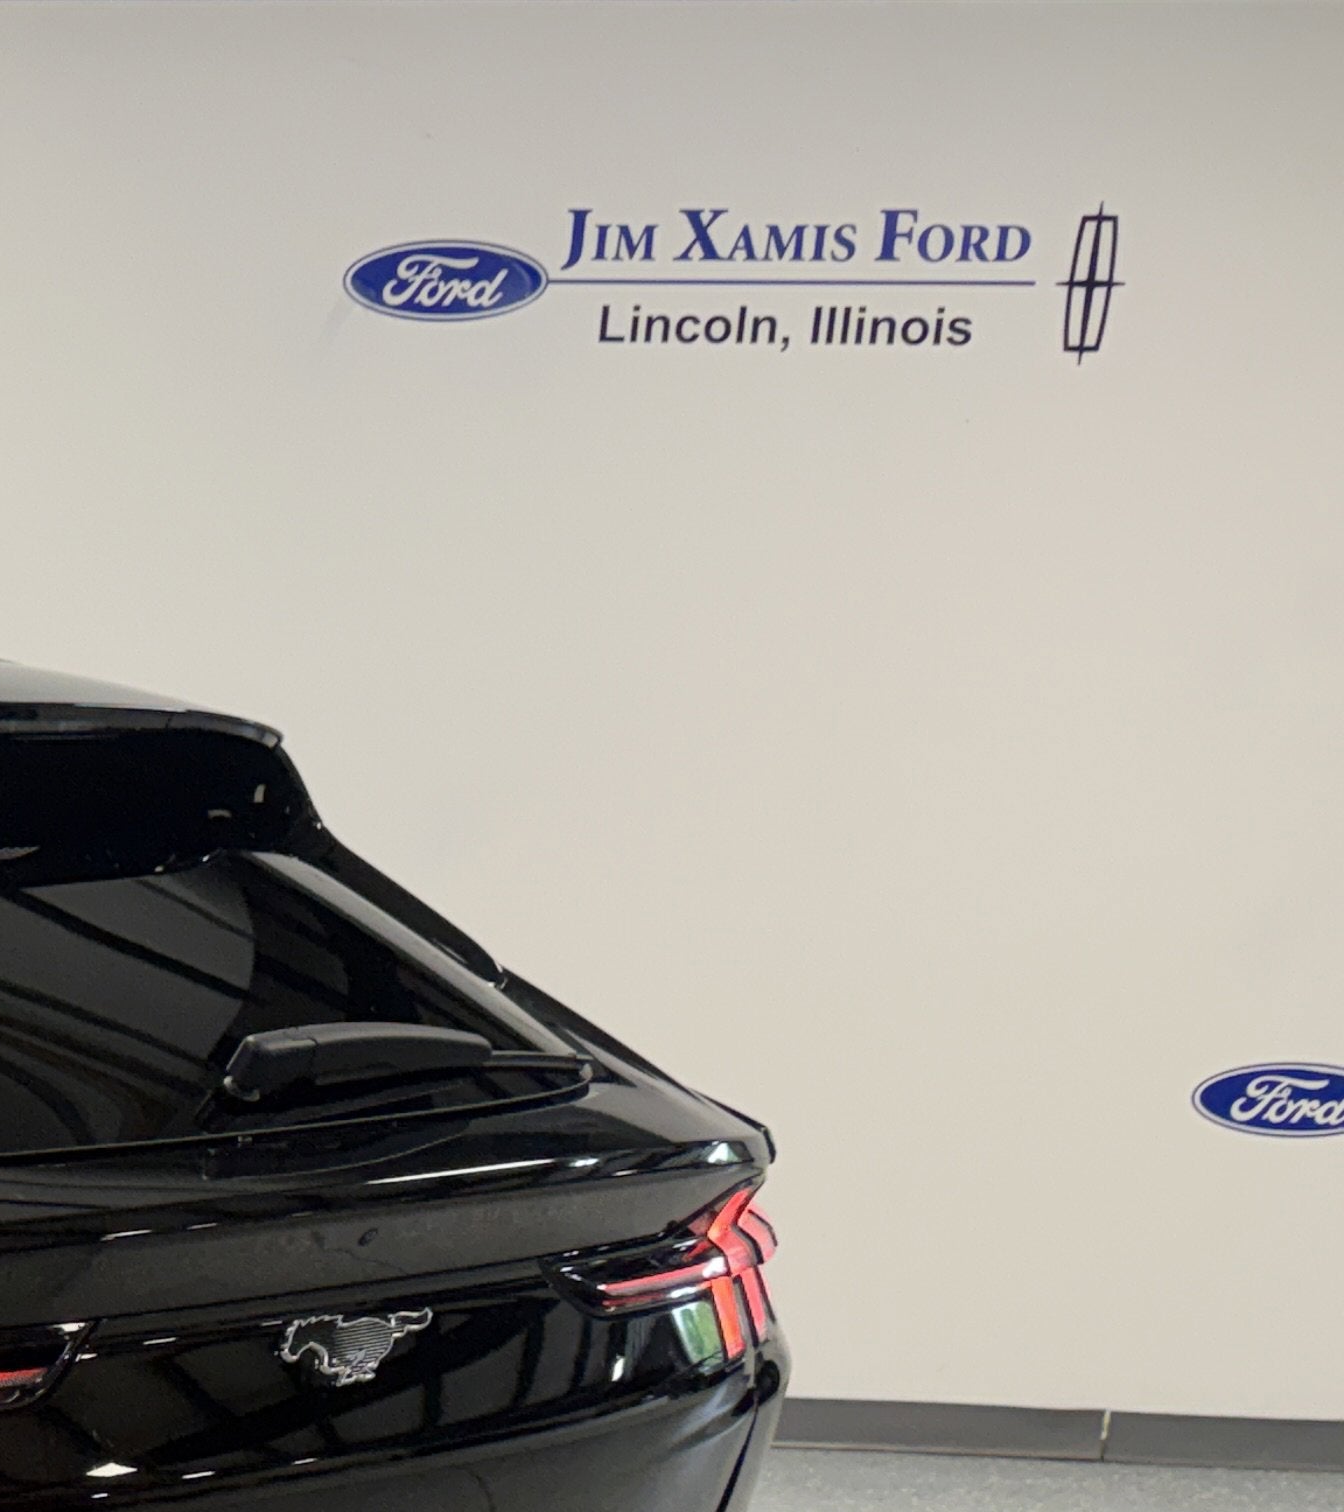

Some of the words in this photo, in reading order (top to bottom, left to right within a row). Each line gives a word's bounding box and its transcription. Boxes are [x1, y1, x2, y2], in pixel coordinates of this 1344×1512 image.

[560, 208, 658, 271] JIM
[673, 209, 857, 263] XAMIS
[876, 209, 1033, 263] FORD
[382, 253, 509, 307] Ford
[598, 304, 791, 352] Lincoln,
[810, 306, 973, 347] Illinois
